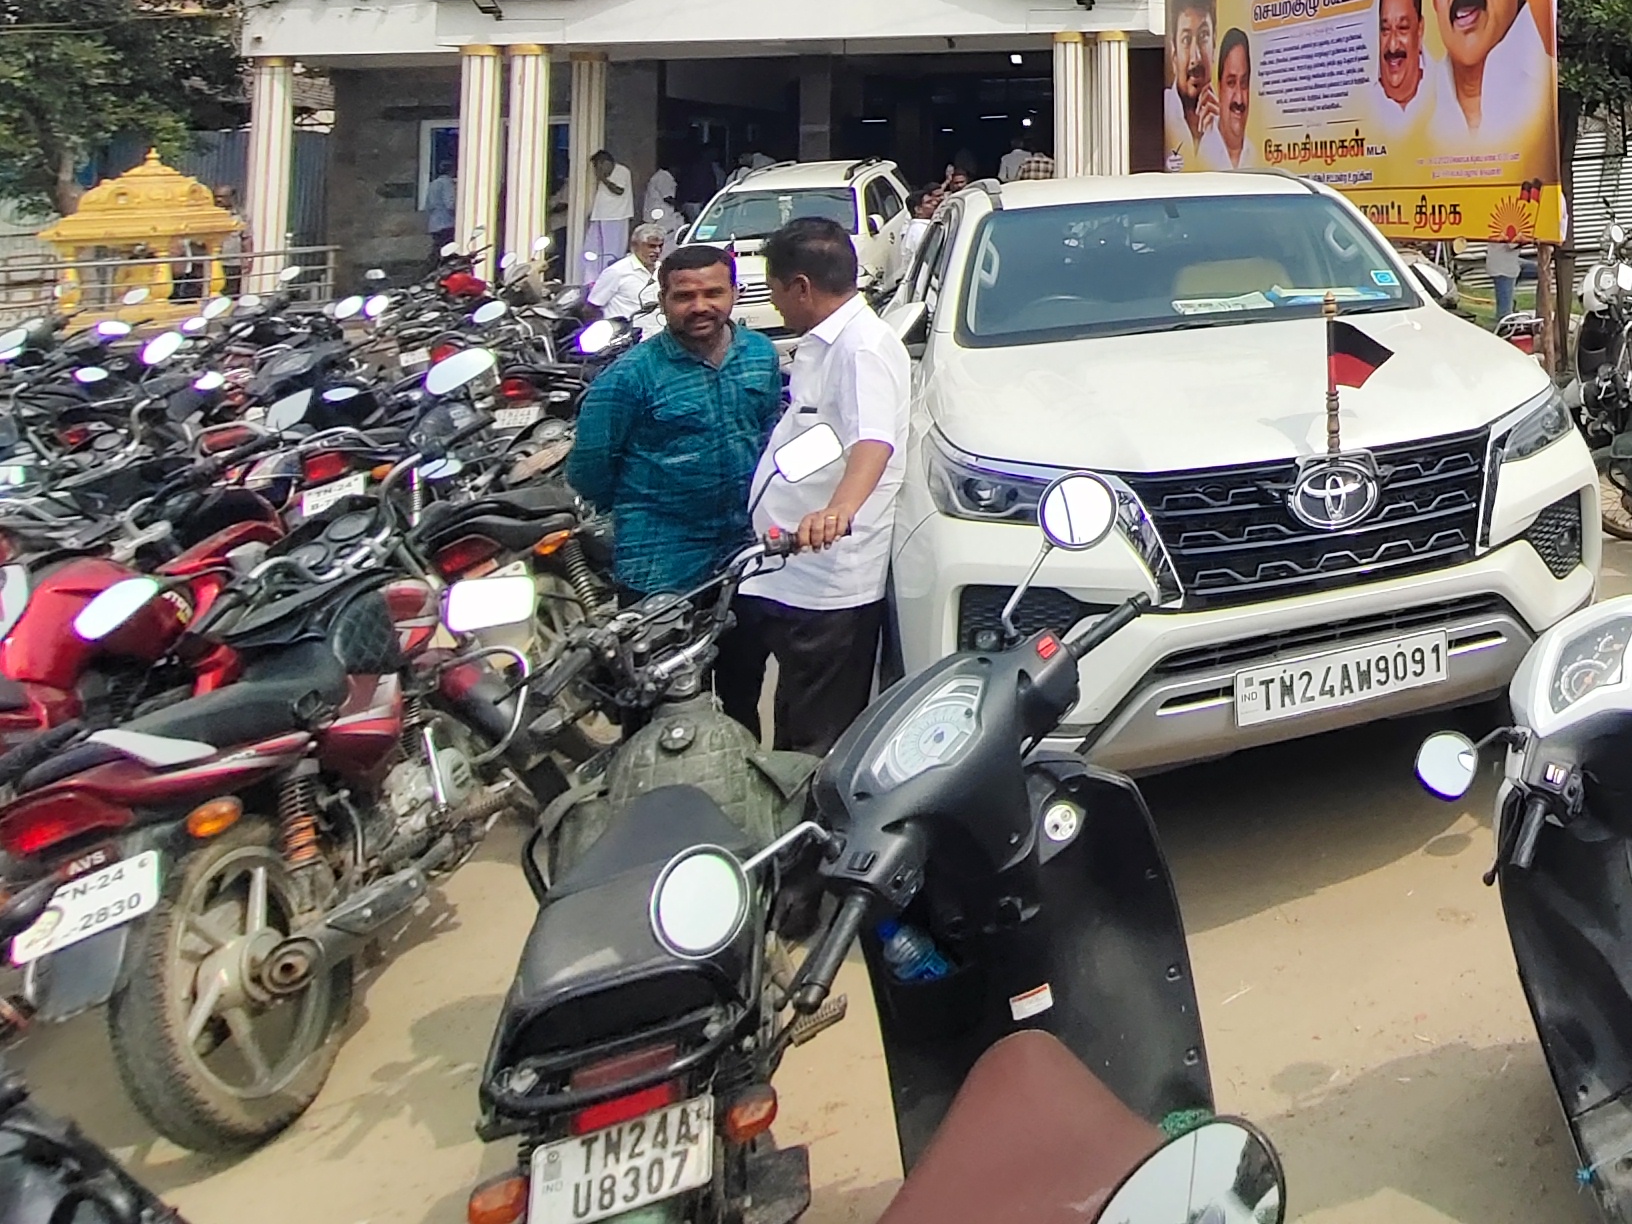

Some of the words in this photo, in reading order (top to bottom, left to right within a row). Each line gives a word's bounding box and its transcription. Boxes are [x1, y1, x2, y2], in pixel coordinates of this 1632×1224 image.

[1366, 144, 1387, 157] MLA
[1413, 194, 1462, 233] திமுக
[1259, 642, 1442, 711] TN24AW9091
[1241, 691, 1258, 703] IND
[67, 849, 106, 875] AVS
[572, 1149, 689, 1218] U8307
